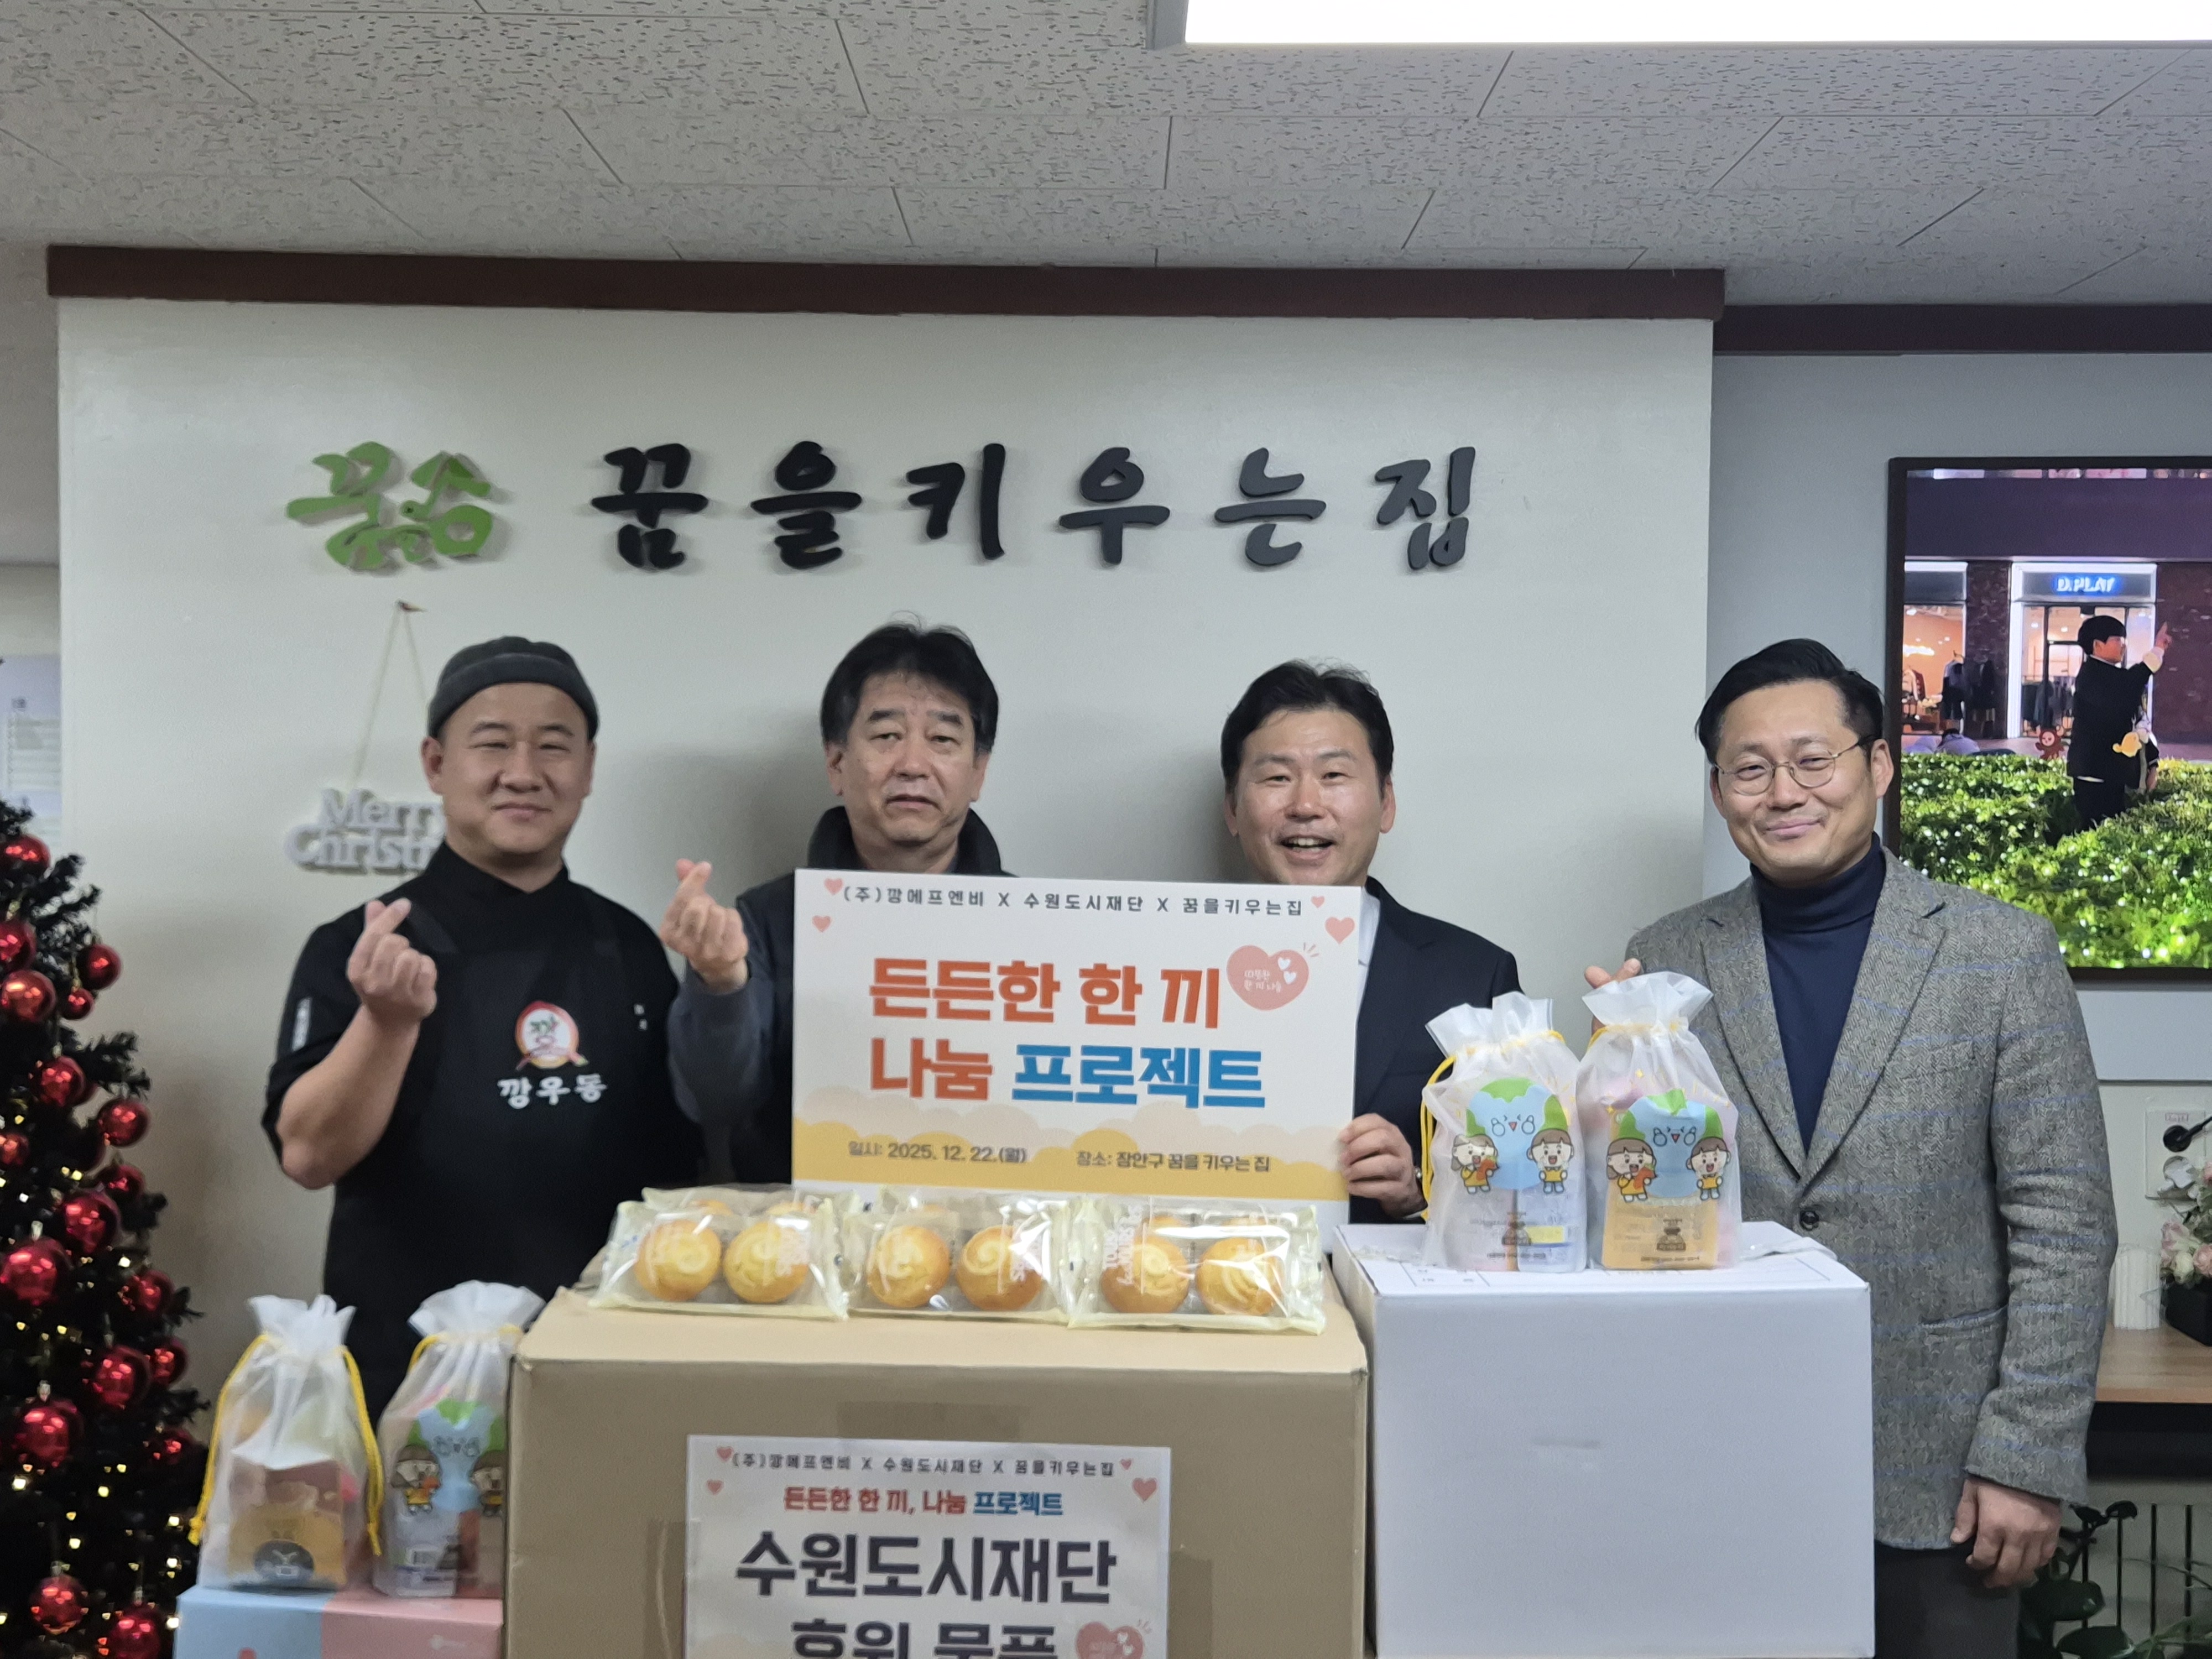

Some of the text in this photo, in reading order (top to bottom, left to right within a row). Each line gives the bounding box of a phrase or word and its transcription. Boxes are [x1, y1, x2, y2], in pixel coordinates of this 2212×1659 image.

[843, 886, 1302, 916] (주)깡에프엔비 X 수원도시재단 X 꿈을키우는집
[869, 958, 1220, 1029] 든든한 한 끼
[870, 1037, 1265, 1108] 나눔 프로젝트
[497, 1072, 608, 1109] 깡우동
[888, 1143, 937, 1160] 2025.
[942, 1145, 966, 1161] 12.
[1077, 1150, 1112, 1166] 장소:
[1116, 1151, 1164, 1168] 장안구
[883, 1457, 983, 1474] 수원도시재단
[1015, 1459, 1114, 1477] 꿈을키우는집
[784, 1486, 1063, 1516] 든든한 한 끼, 나눔 프로젝트
[735, 1531, 1117, 1603] 수원도시재단
